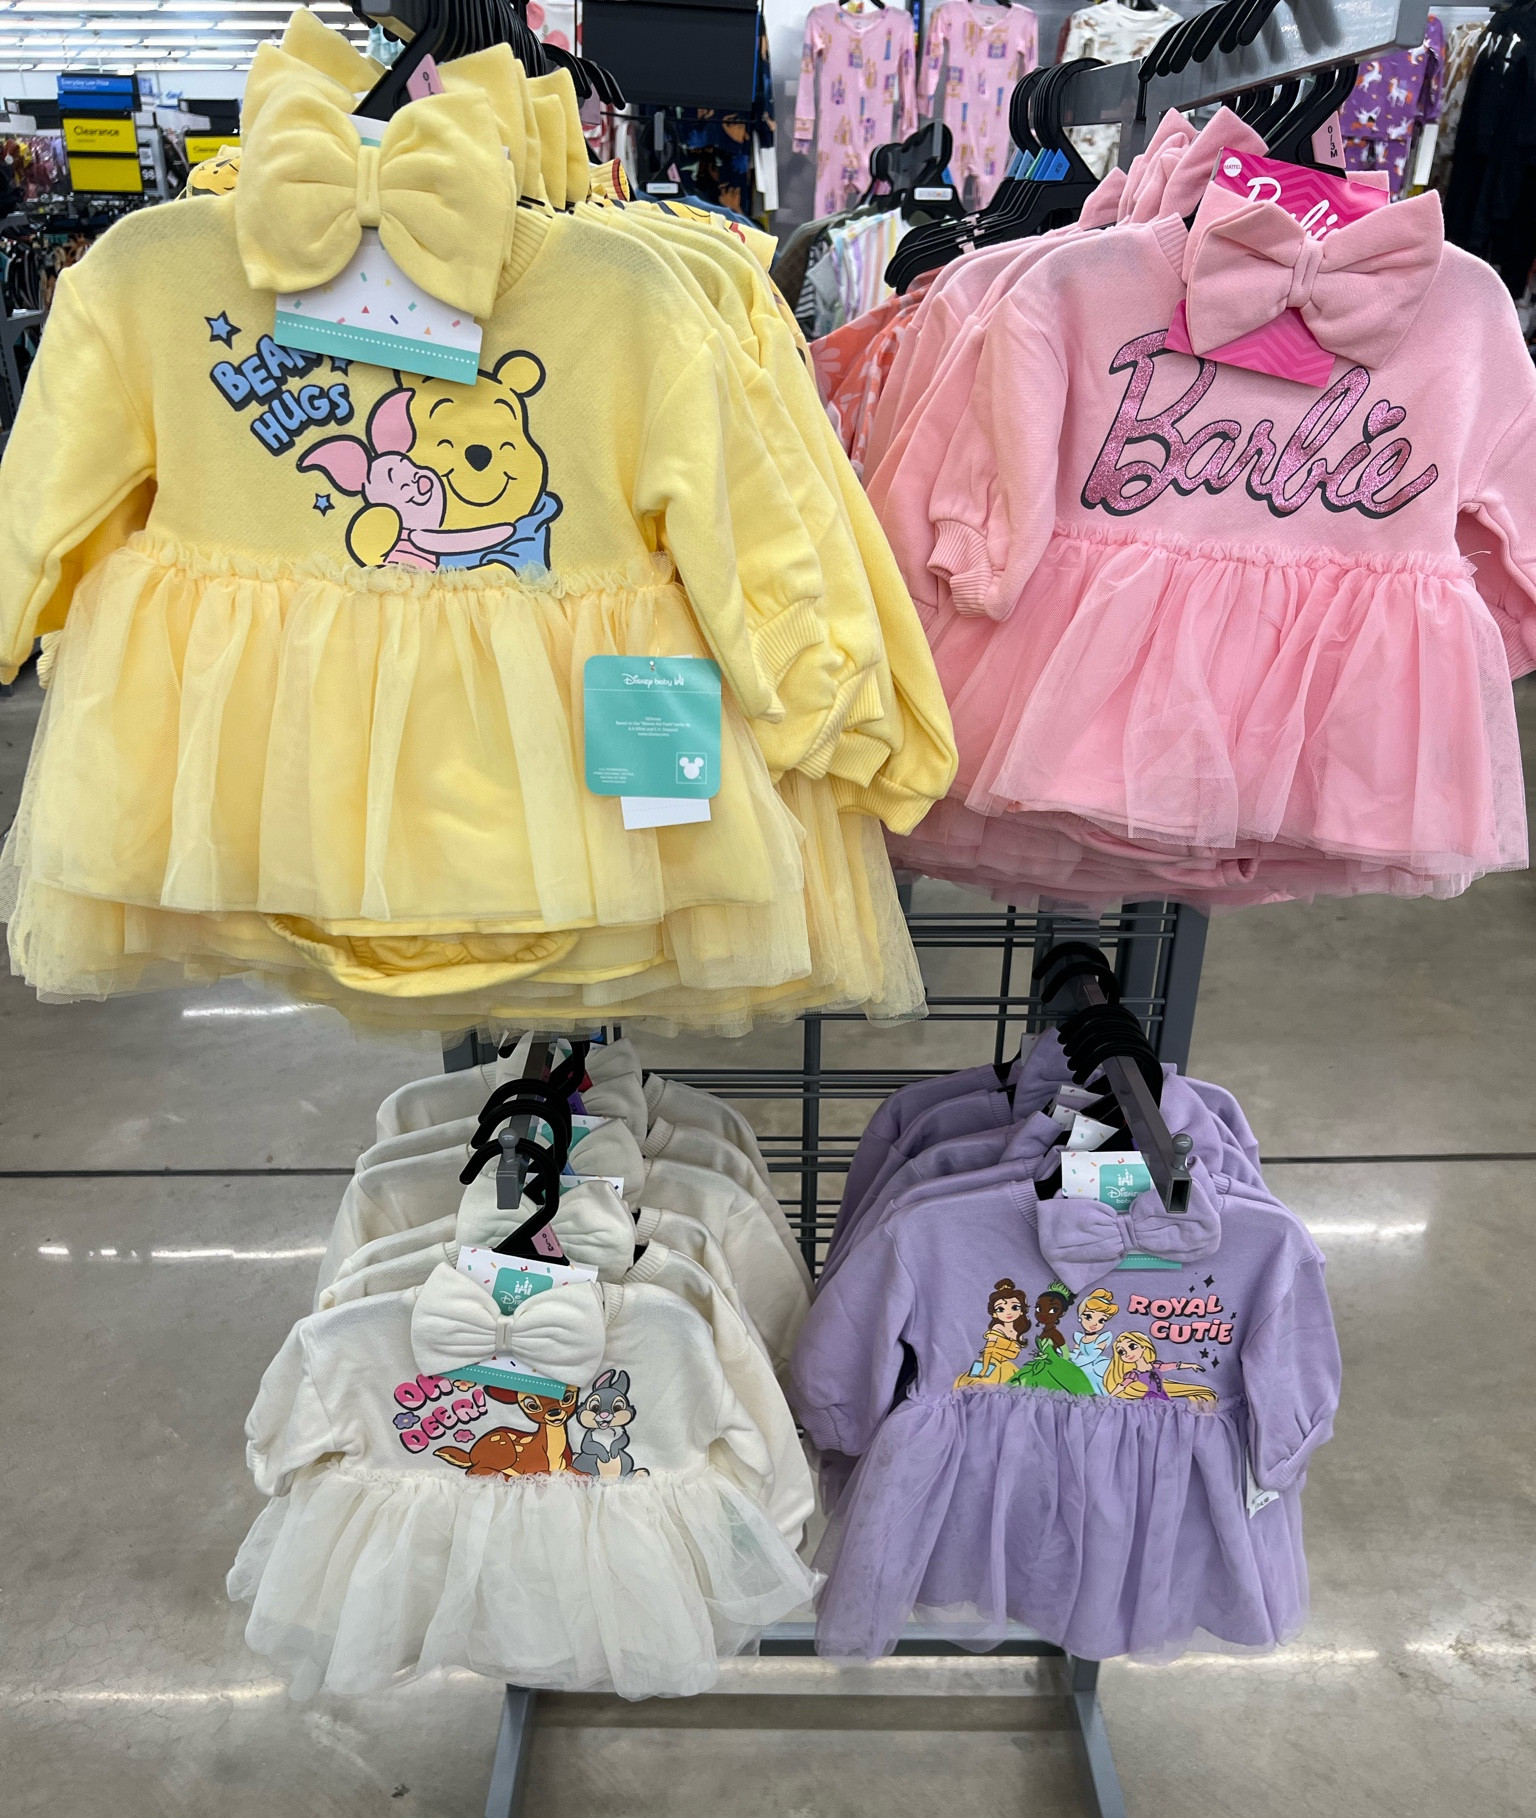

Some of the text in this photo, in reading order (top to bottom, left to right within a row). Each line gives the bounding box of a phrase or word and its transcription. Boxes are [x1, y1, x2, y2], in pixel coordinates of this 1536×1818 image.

[73, 125, 120, 137] Clearance
[250, 383, 354, 456] HUGS
[1081, 329, 1438, 519] Barbie
[621, 673, 673, 688] Disney baby
[1127, 1293, 1224, 1319] ROYAL
[393, 1373, 454, 1411] OH
[399, 1388, 488, 1454] DEER!
